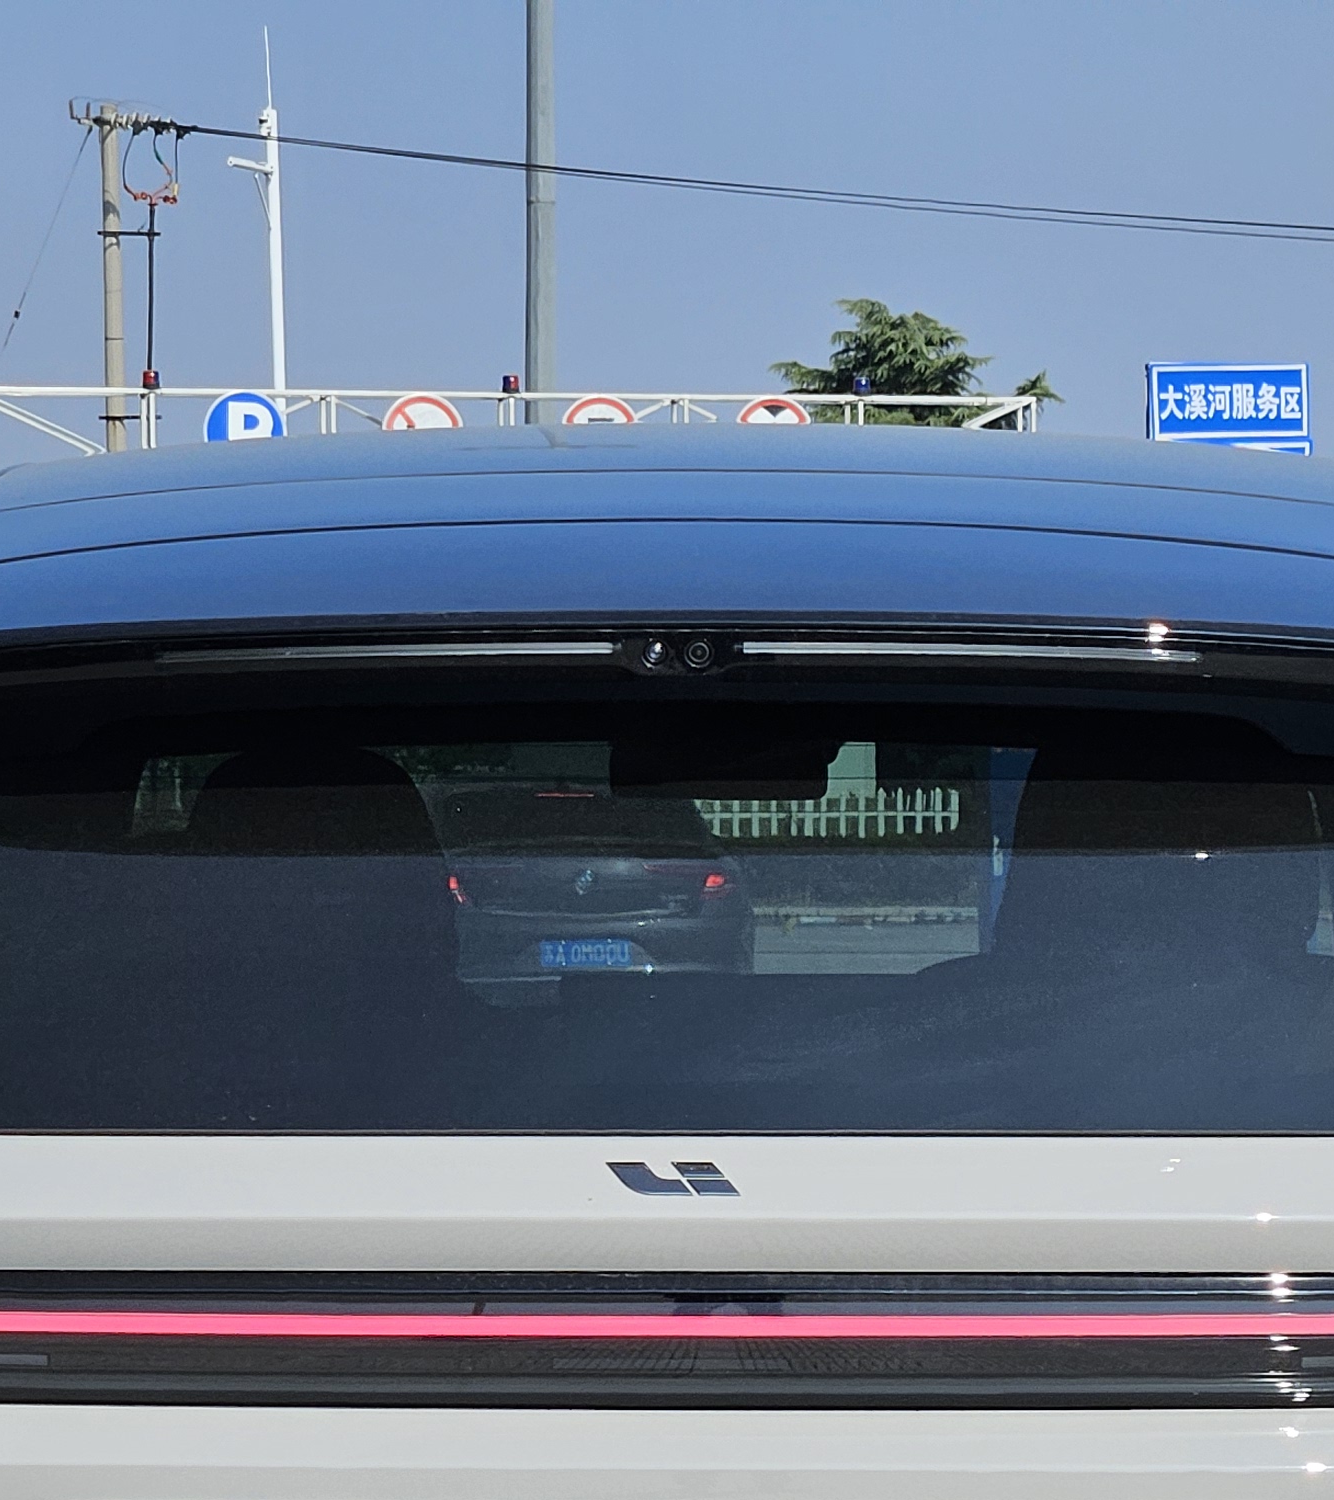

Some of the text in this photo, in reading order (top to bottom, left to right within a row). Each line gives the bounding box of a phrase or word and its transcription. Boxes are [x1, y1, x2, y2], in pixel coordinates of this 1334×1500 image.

[227, 401, 274, 441] P
[1159, 382, 1302, 421] 大溪河服务区
